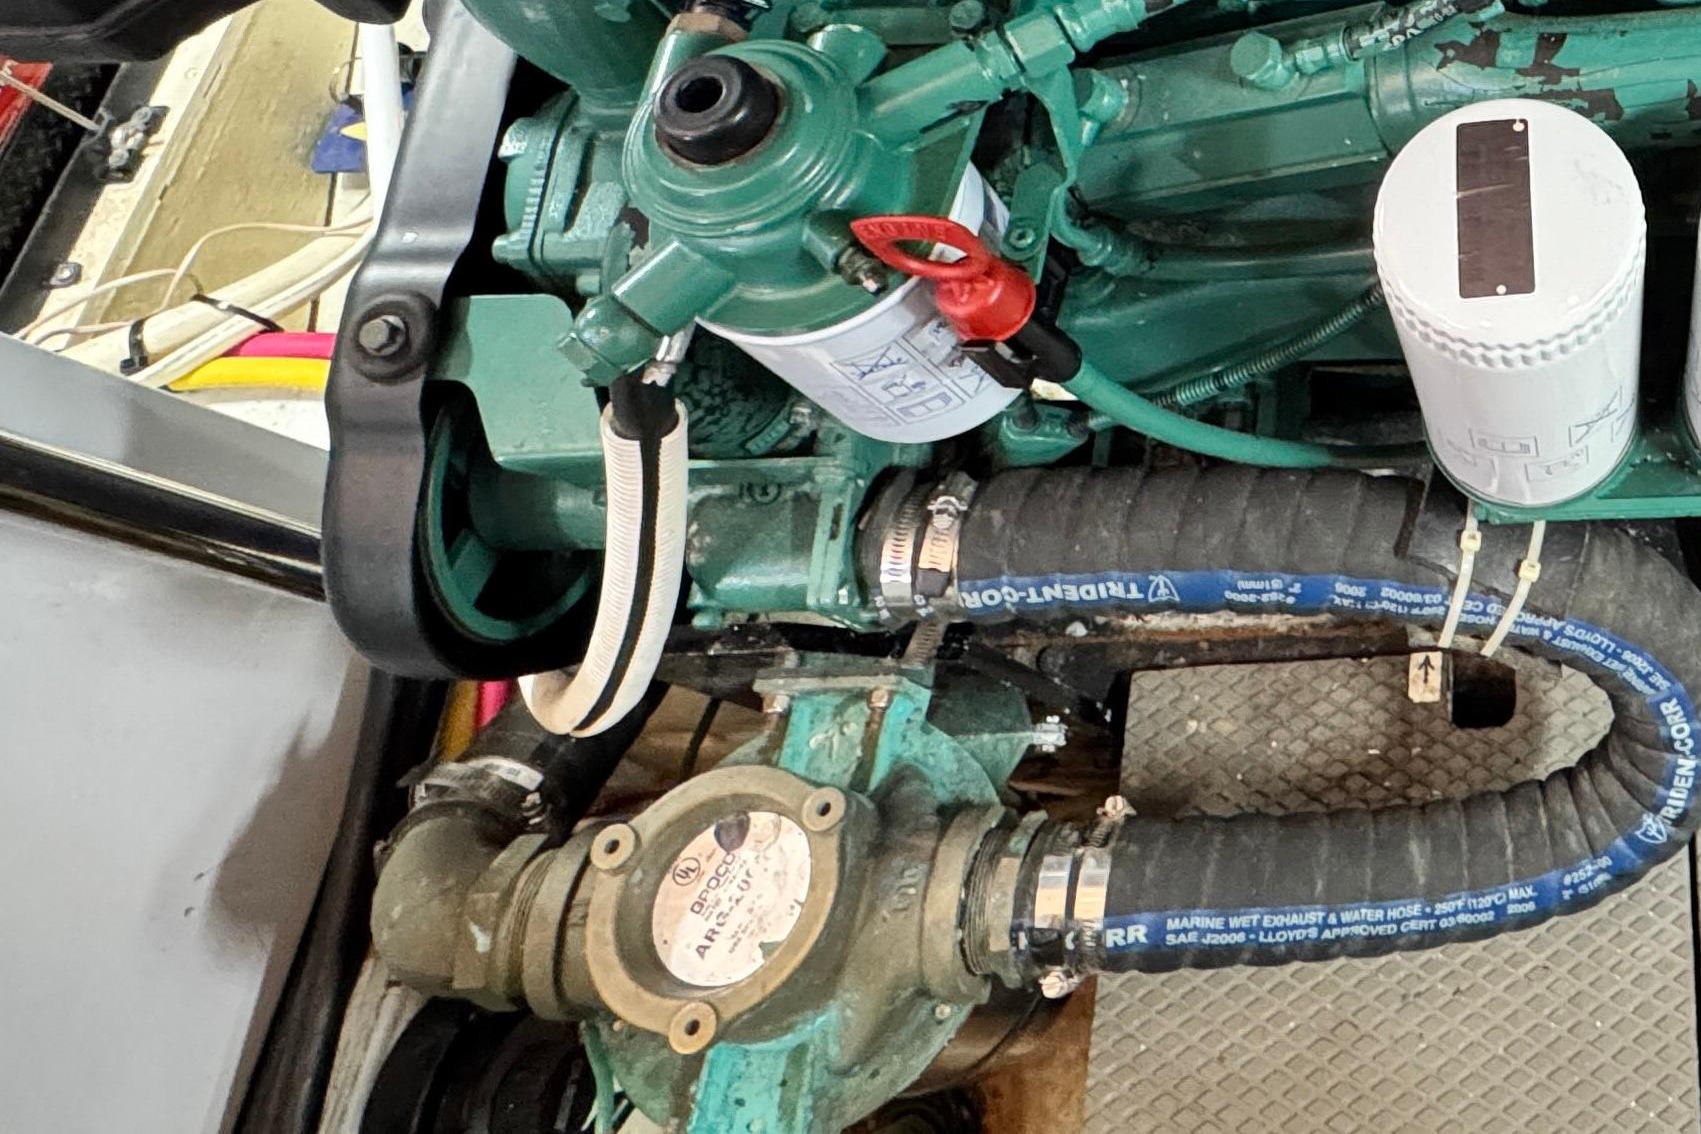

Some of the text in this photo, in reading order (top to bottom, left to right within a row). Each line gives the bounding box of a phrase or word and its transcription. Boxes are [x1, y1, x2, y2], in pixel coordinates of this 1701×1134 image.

[960, 580, 1143, 610] TRIDENT-COR
[1445, 596, 1484, 614] CET
[1487, 602, 1566, 631] APPROED
[1165, 930, 1199, 947] SAE
[1321, 921, 1397, 941] APPROVED
[1400, 916, 1437, 933] CERT
[1166, 916, 1225, 932] MARINE
[1228, 913, 1260, 929] WET
[1262, 911, 1326, 928] EXHAUST
[1327, 911, 1338, 925] &
[1340, 907, 1385, 924] WATER
[1386, 903, 1421, 921] HOSE
